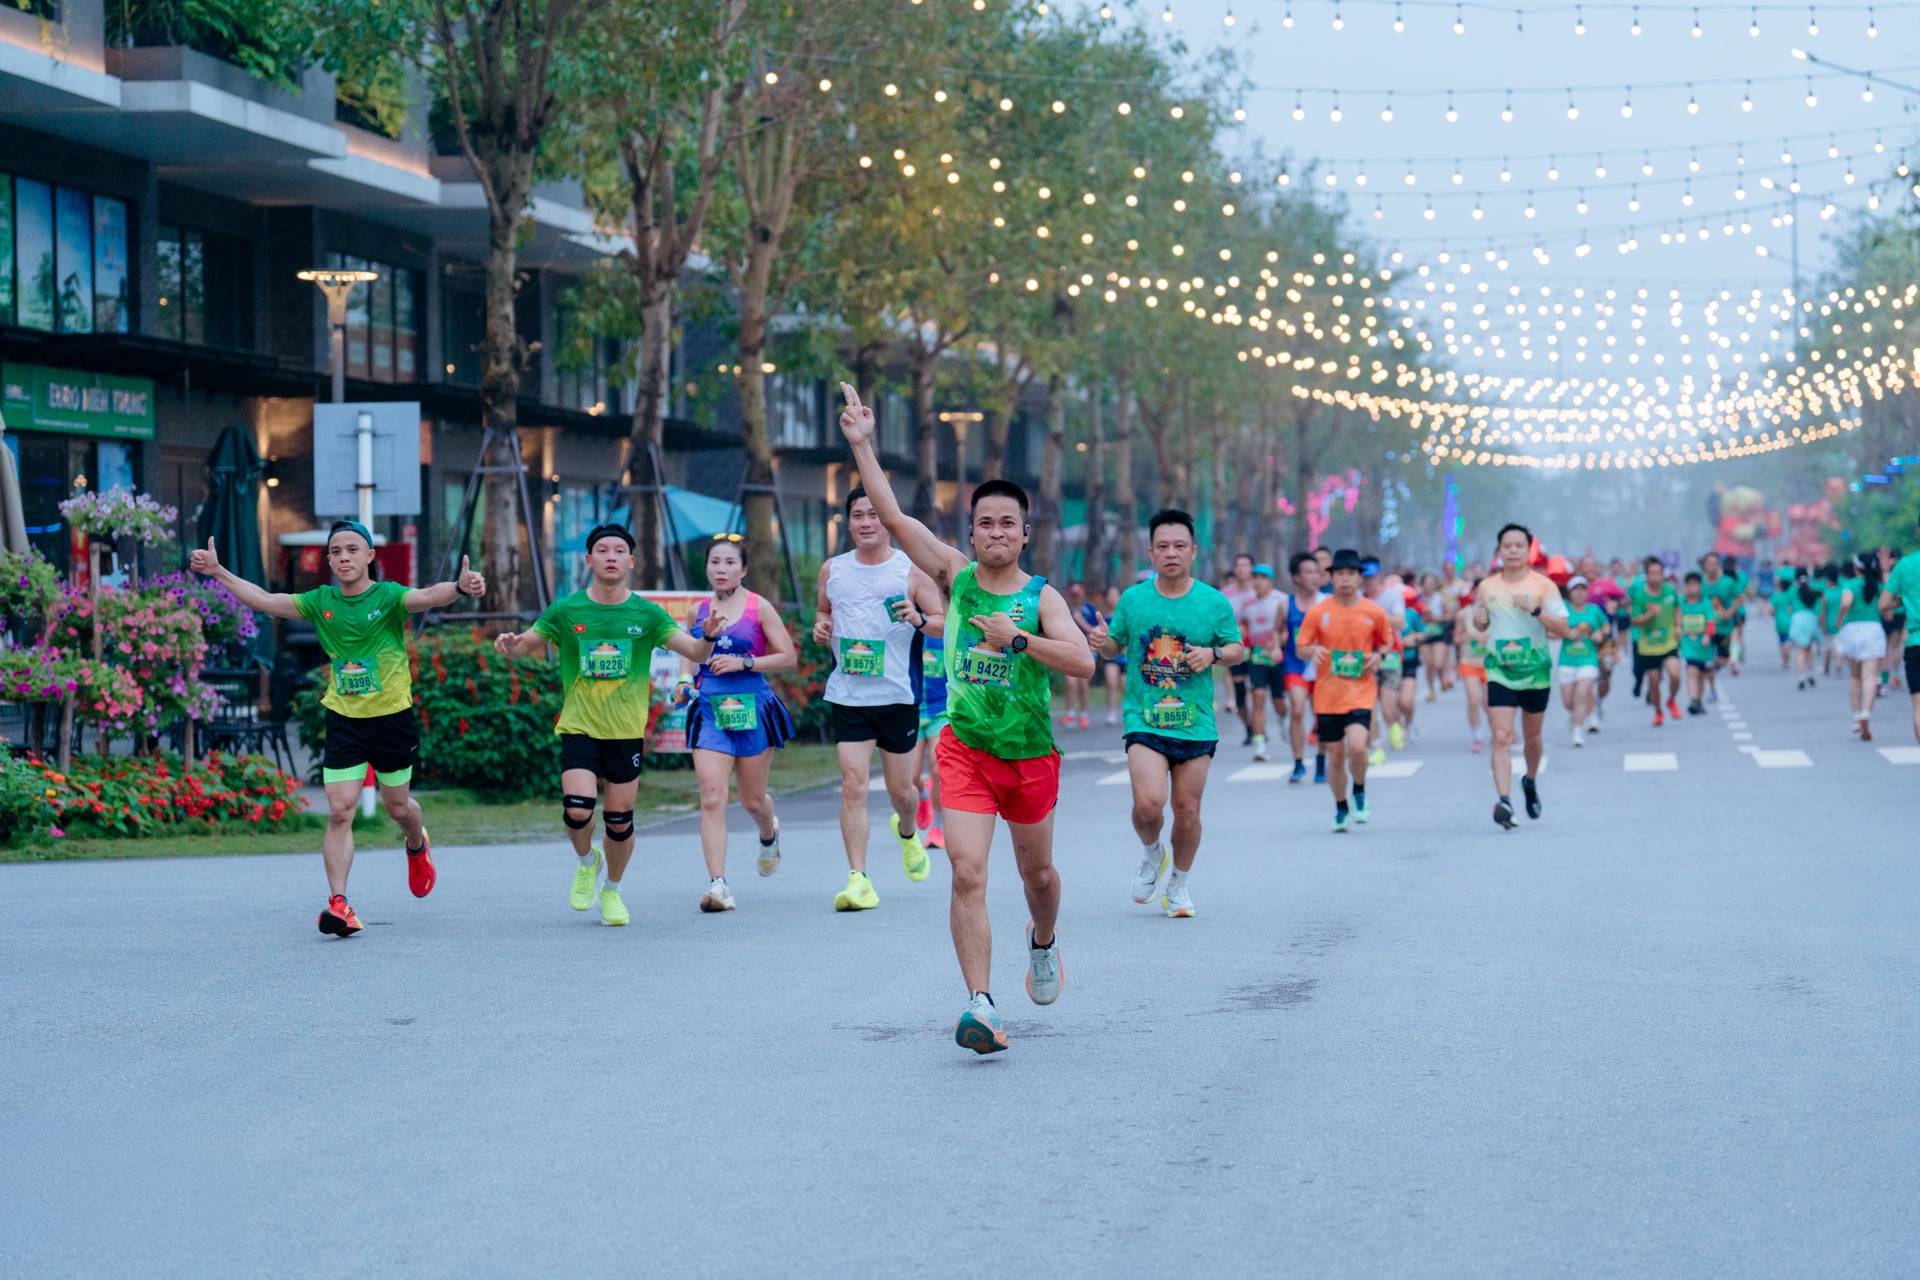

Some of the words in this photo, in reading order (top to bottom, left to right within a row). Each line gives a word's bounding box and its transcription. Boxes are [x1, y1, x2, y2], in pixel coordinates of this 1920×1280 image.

[588, 660, 596, 670] M
[600, 659, 623, 671] 9226
[853, 658, 875, 669] 9575
[962, 658, 972, 673] M
[976, 660, 1008, 679] 9422
[725, 713, 747, 724] 9550
[1164, 710, 1187, 721] 9559
